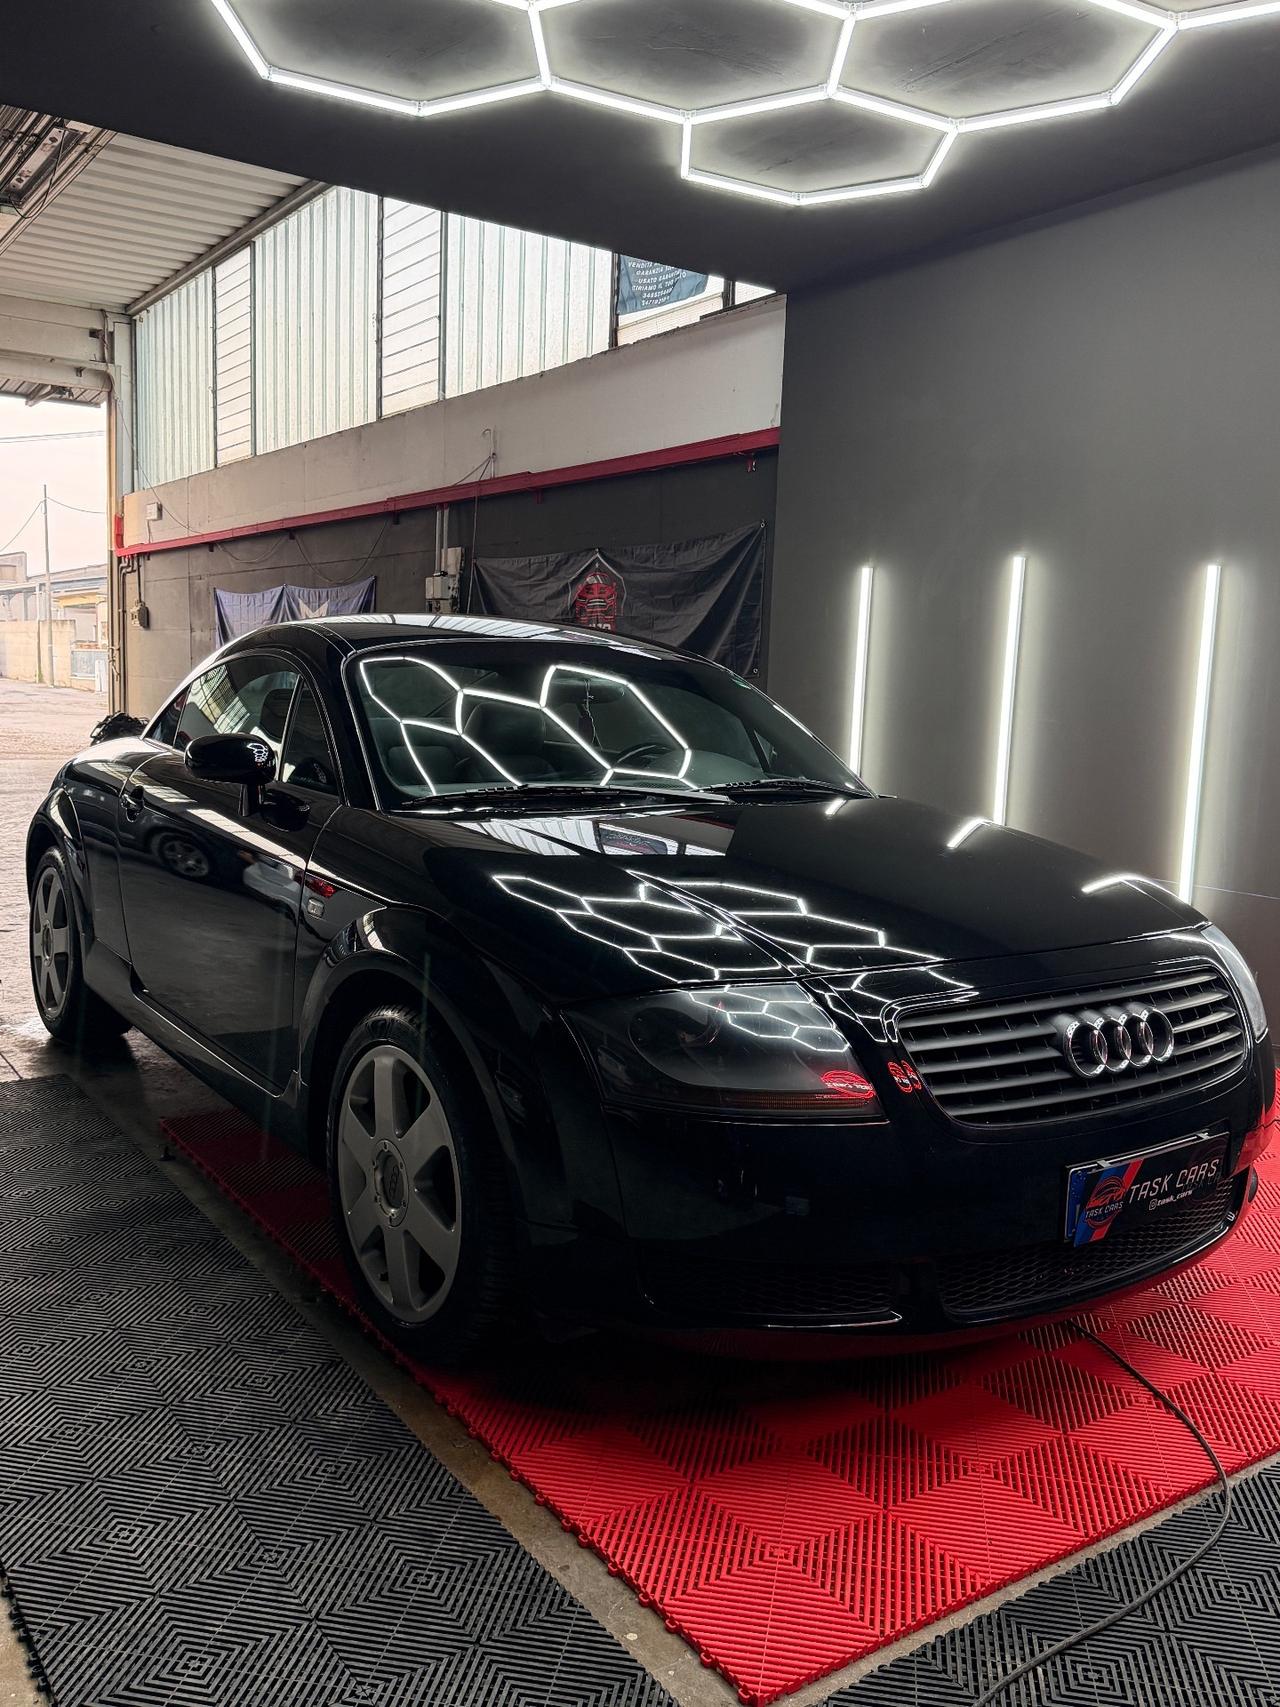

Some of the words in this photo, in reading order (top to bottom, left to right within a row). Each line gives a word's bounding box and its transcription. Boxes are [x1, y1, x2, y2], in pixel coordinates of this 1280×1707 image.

[1129, 1173, 1173, 1205] TASK
[1176, 1159, 1220, 1189] CARS
[1085, 1207, 1104, 1219] TASK
[1104, 1201, 1124, 1214] CARS
